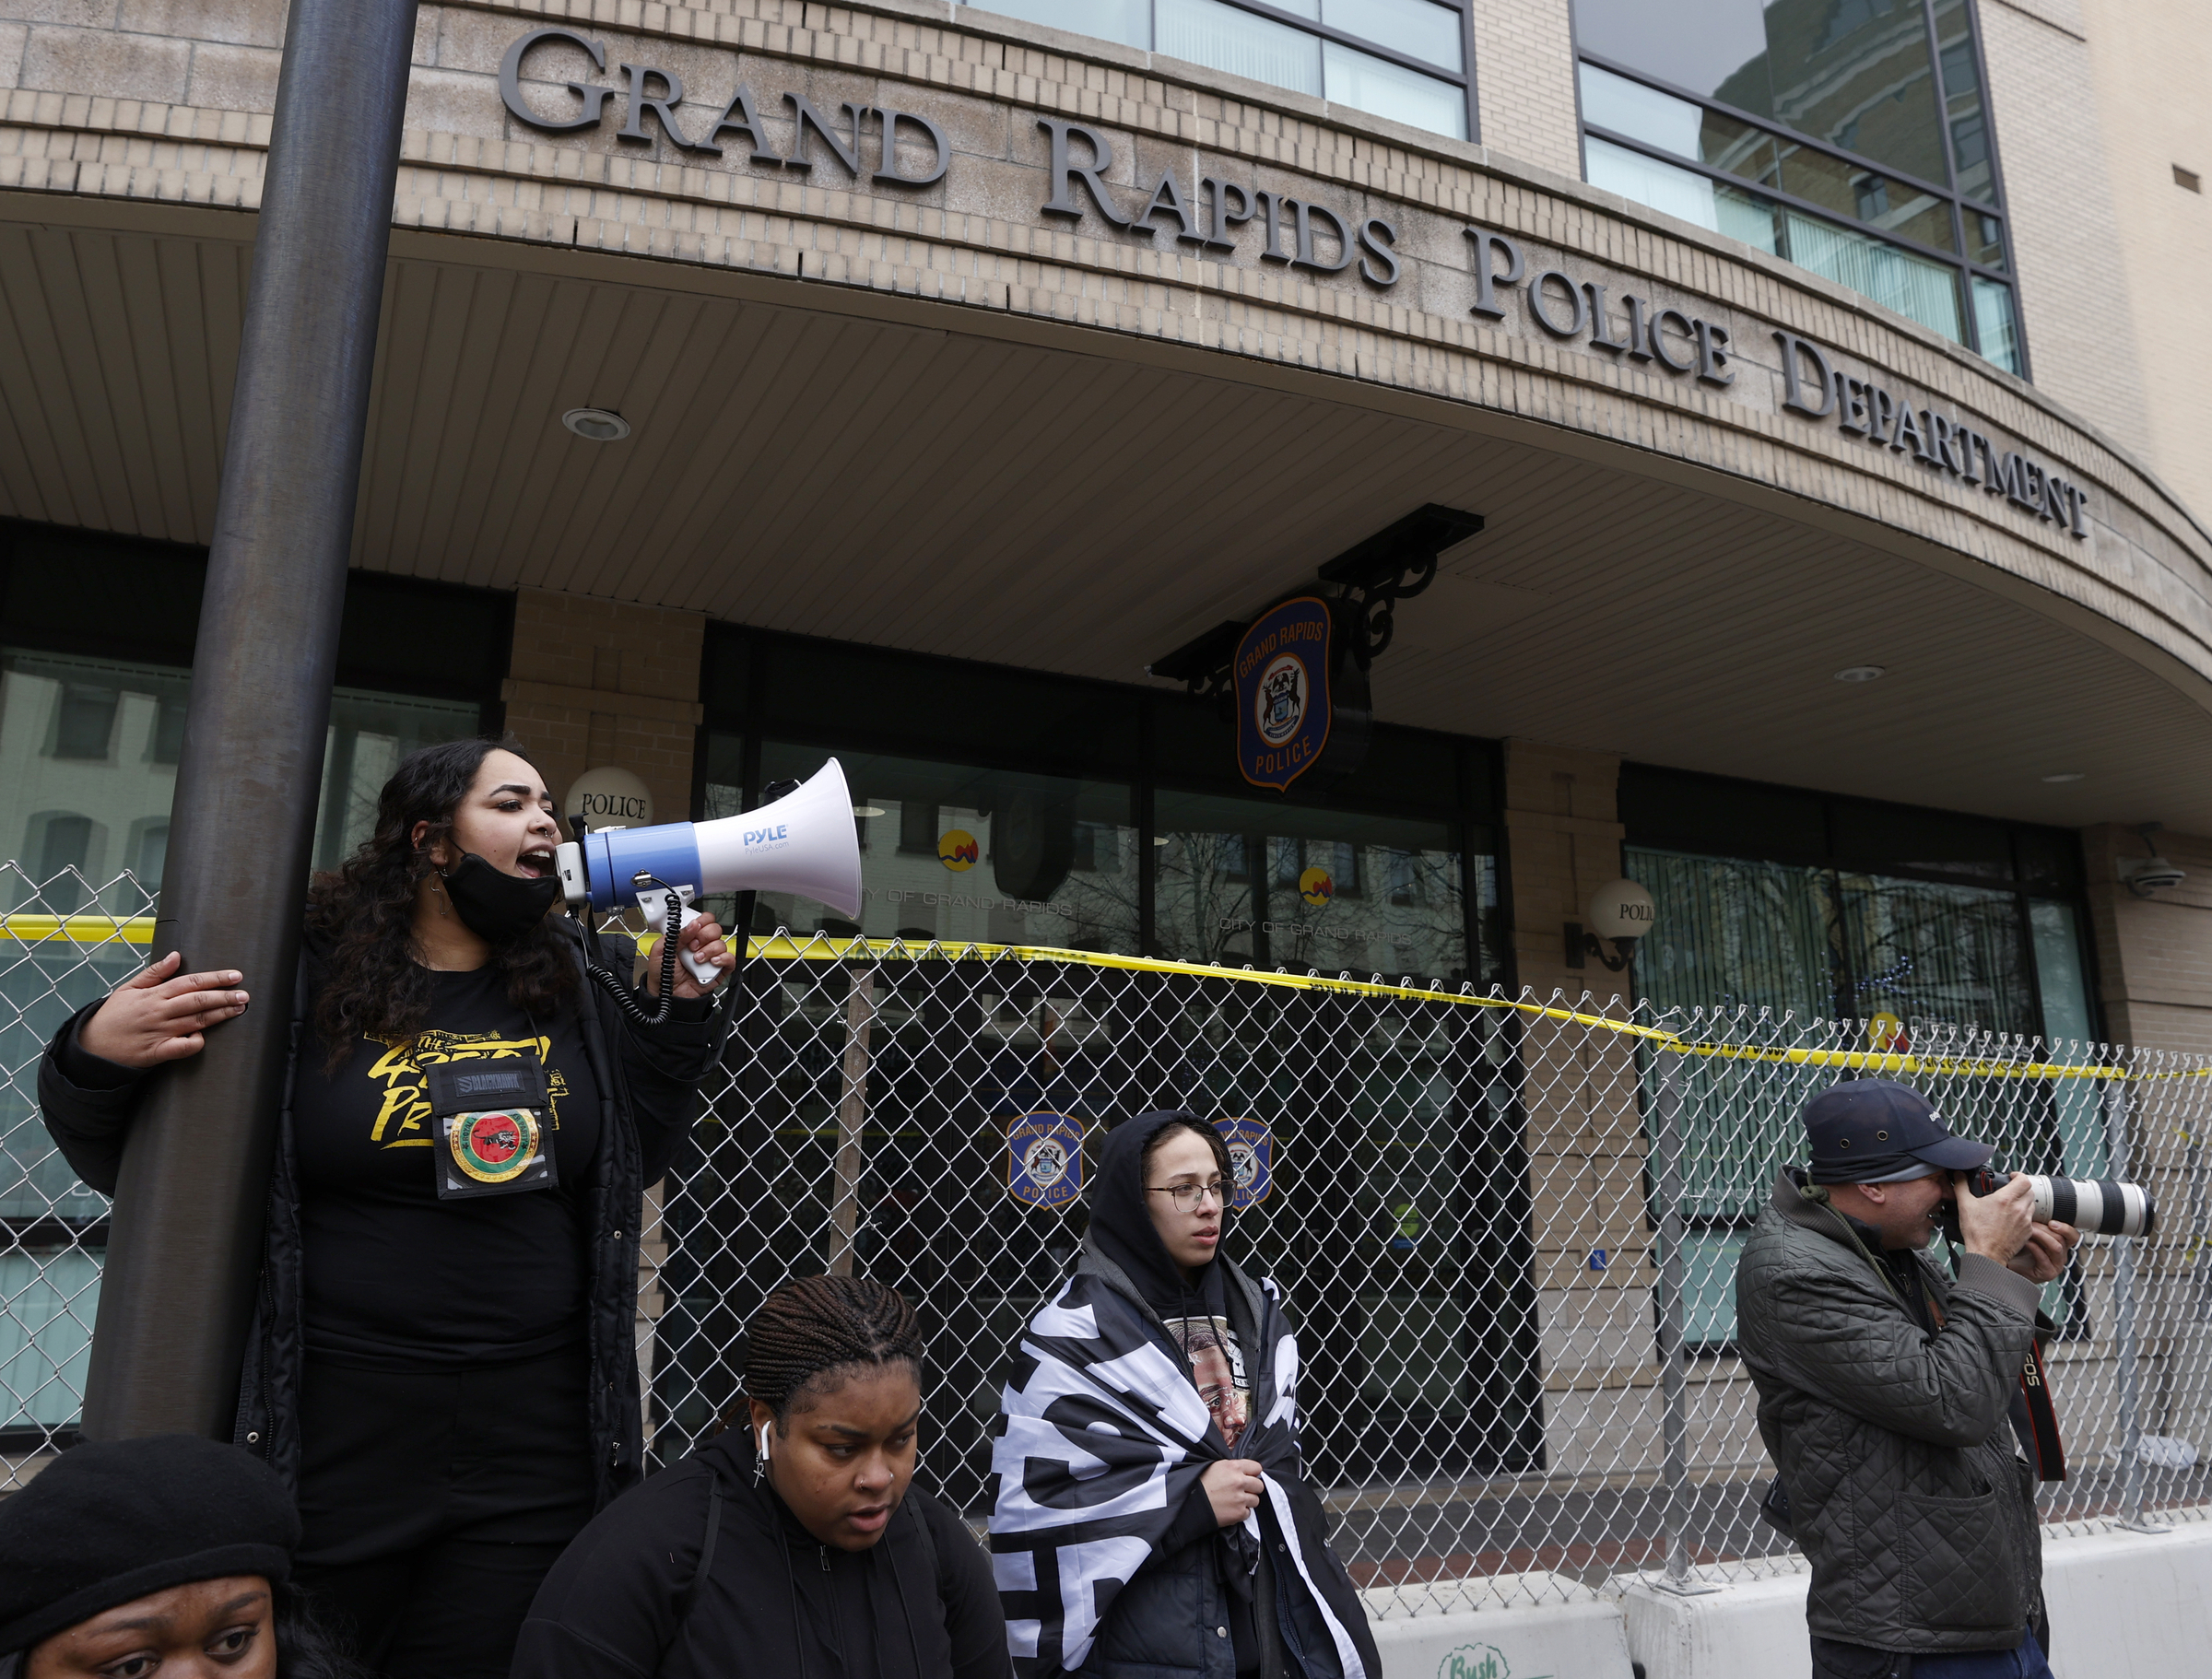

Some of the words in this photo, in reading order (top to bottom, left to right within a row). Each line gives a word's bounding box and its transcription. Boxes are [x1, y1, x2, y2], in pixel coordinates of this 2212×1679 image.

[499, 27, 952, 186] GRAND
[1037, 119, 1400, 288] RAPIDS
[1463, 227, 1735, 387] POLICE
[1772, 330, 2088, 540] DEPARTMENT
[1239, 632, 1277, 679] GRAND
[1279, 621, 1324, 646] RAPIDS
[1254, 735, 1312, 775] POLICE
[582, 793, 647, 820] POLICE
[743, 824, 787, 846] PYLE
[744, 841, 790, 856] PyleUSA.com
[887, 889, 915, 903] OF
[923, 891, 995, 910] GRAND
[1003, 899, 1073, 917] RAPIDS
[1218, 917, 1256, 932] CITY
[1262, 922, 1285, 934] OF
[1290, 923, 1349, 941] GRAND
[1355, 929, 1413, 945] RAPIDS
[471, 1073, 521, 1091] BLACKHAWK
[463, 1120, 474, 1142] ROYAL
[1013, 1123, 1044, 1141] GRAND
[1022, 1186, 1068, 1199] POICE
[1450, 1652, 1498, 1679] Bush
